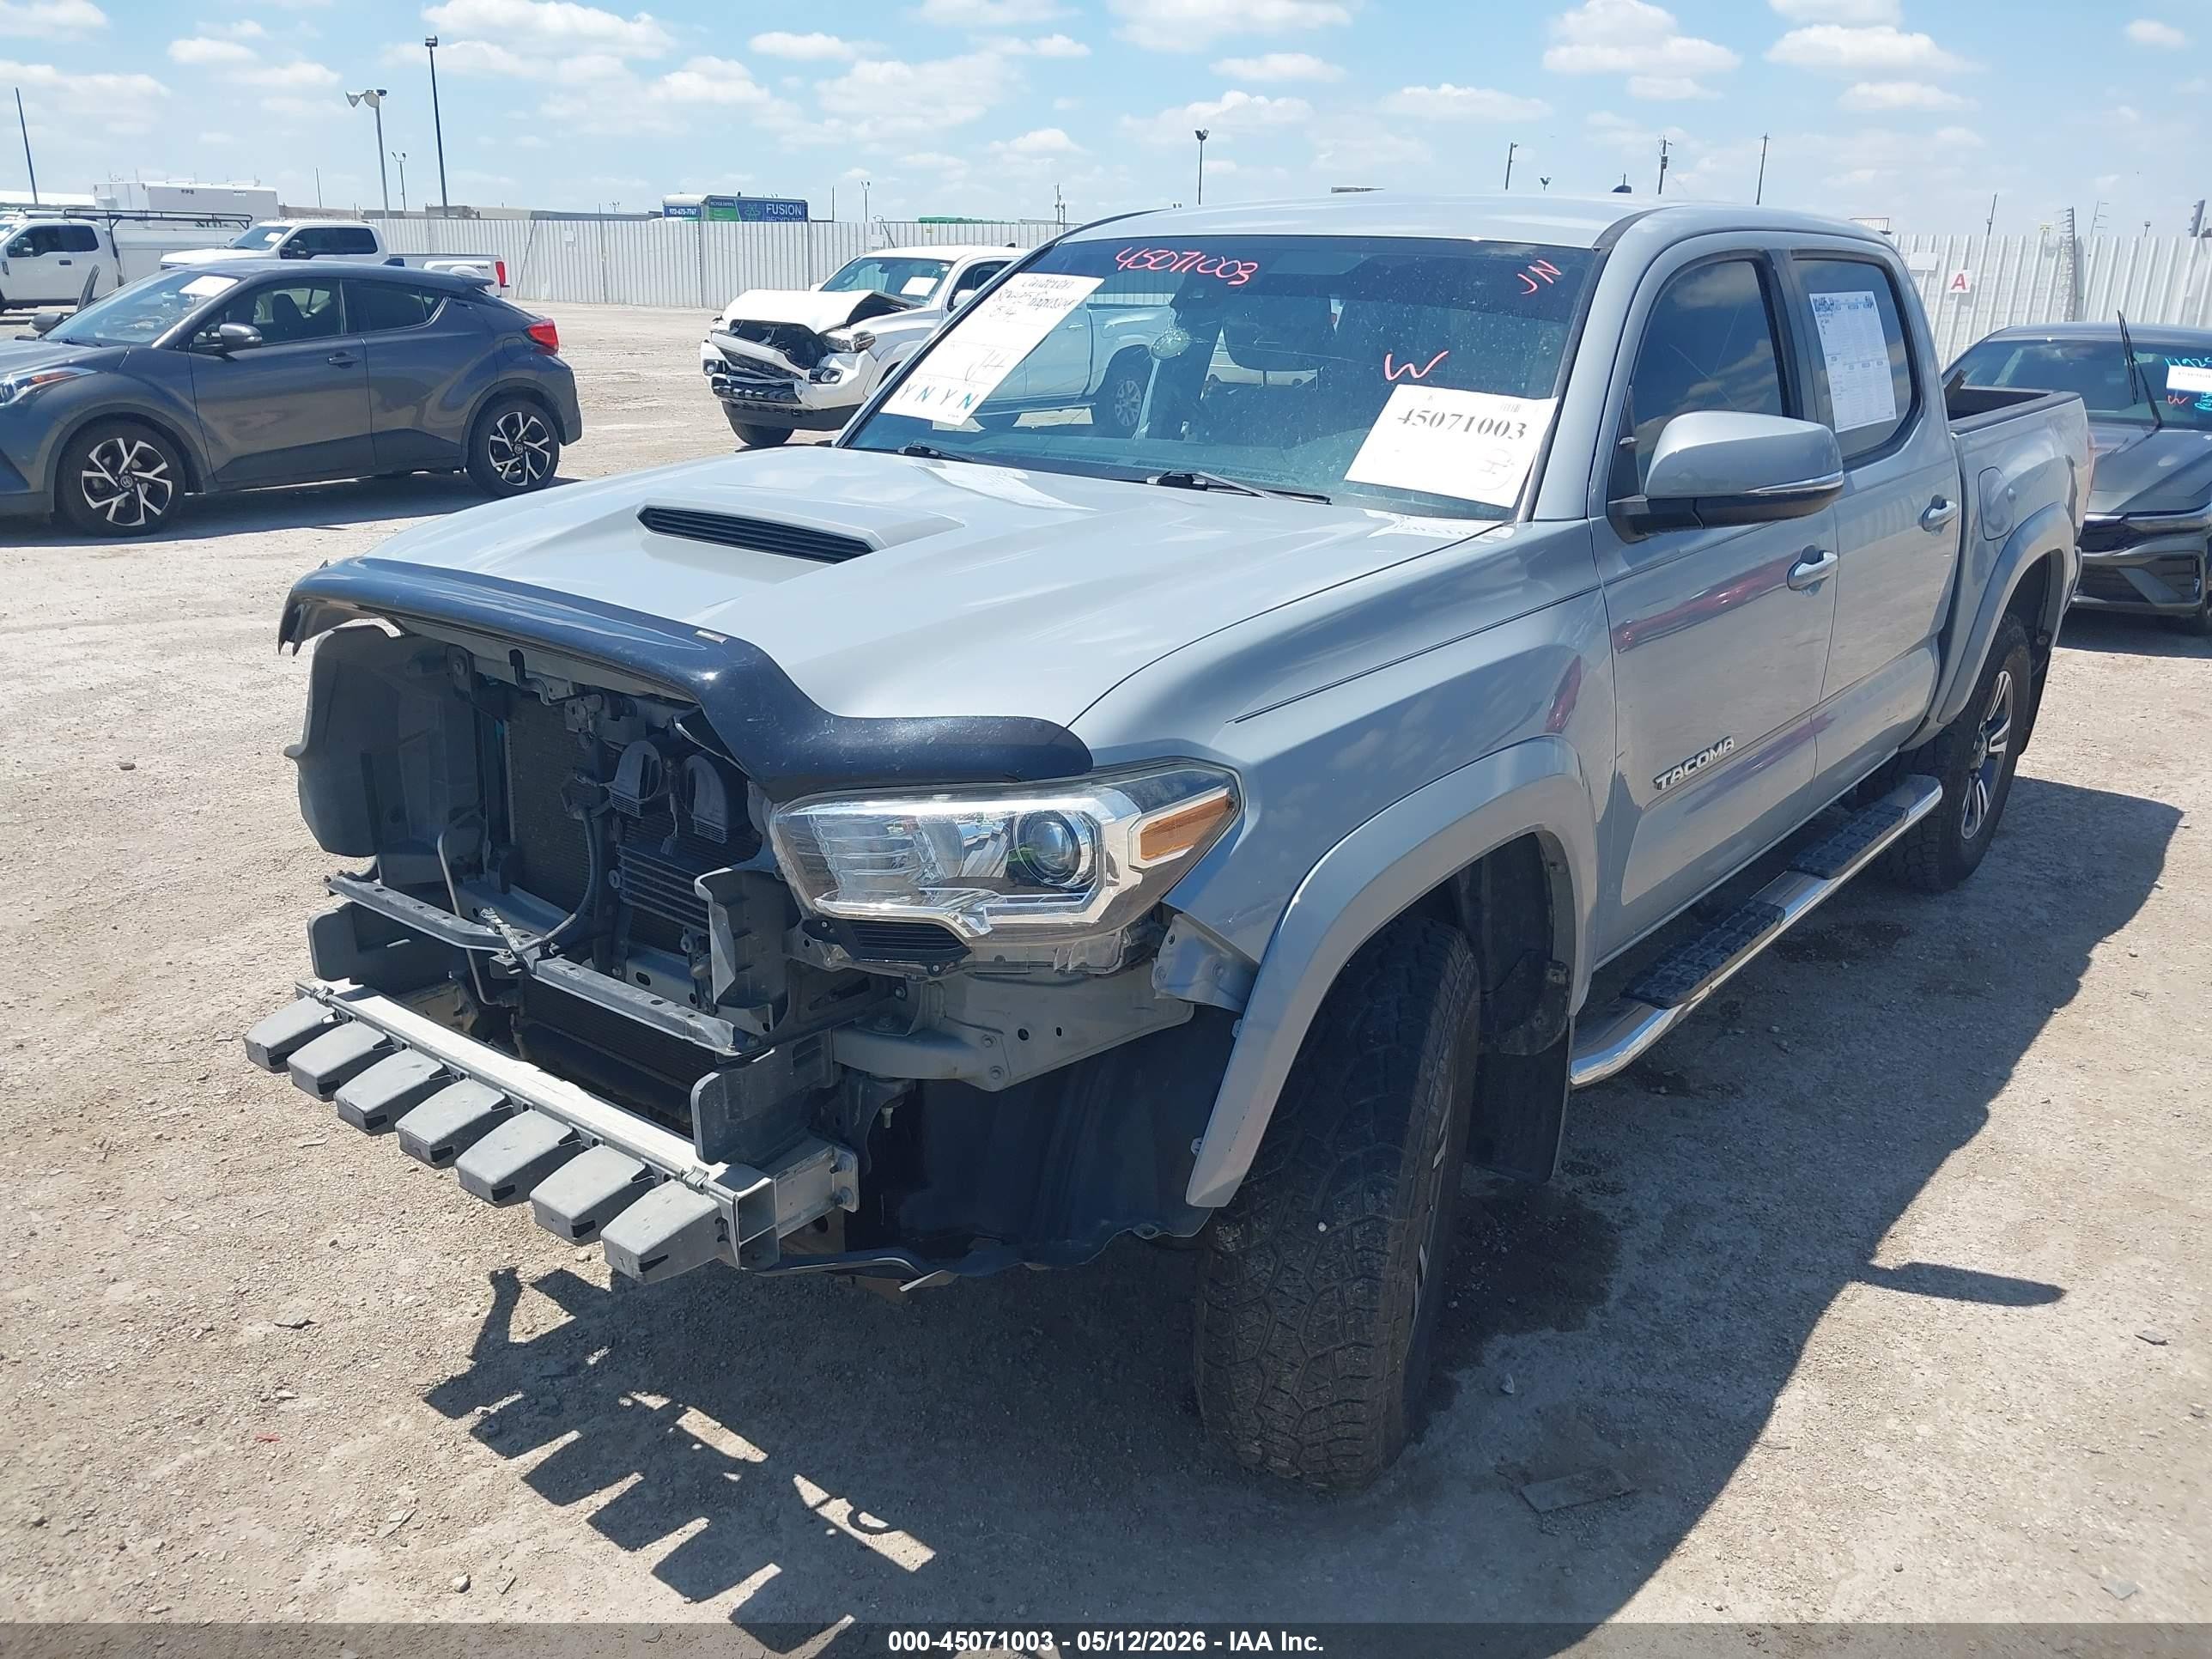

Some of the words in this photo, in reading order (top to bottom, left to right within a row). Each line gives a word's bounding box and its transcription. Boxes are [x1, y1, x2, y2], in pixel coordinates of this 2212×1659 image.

[766, 204, 802, 216] FUSION
[1115, 247, 1259, 286] 45071003
[1951, 273, 1966, 290] A
[1383, 349, 1450, 381] W
[1397, 406, 1528, 441] 45071003
[1653, 735, 1735, 791] TACOMA
